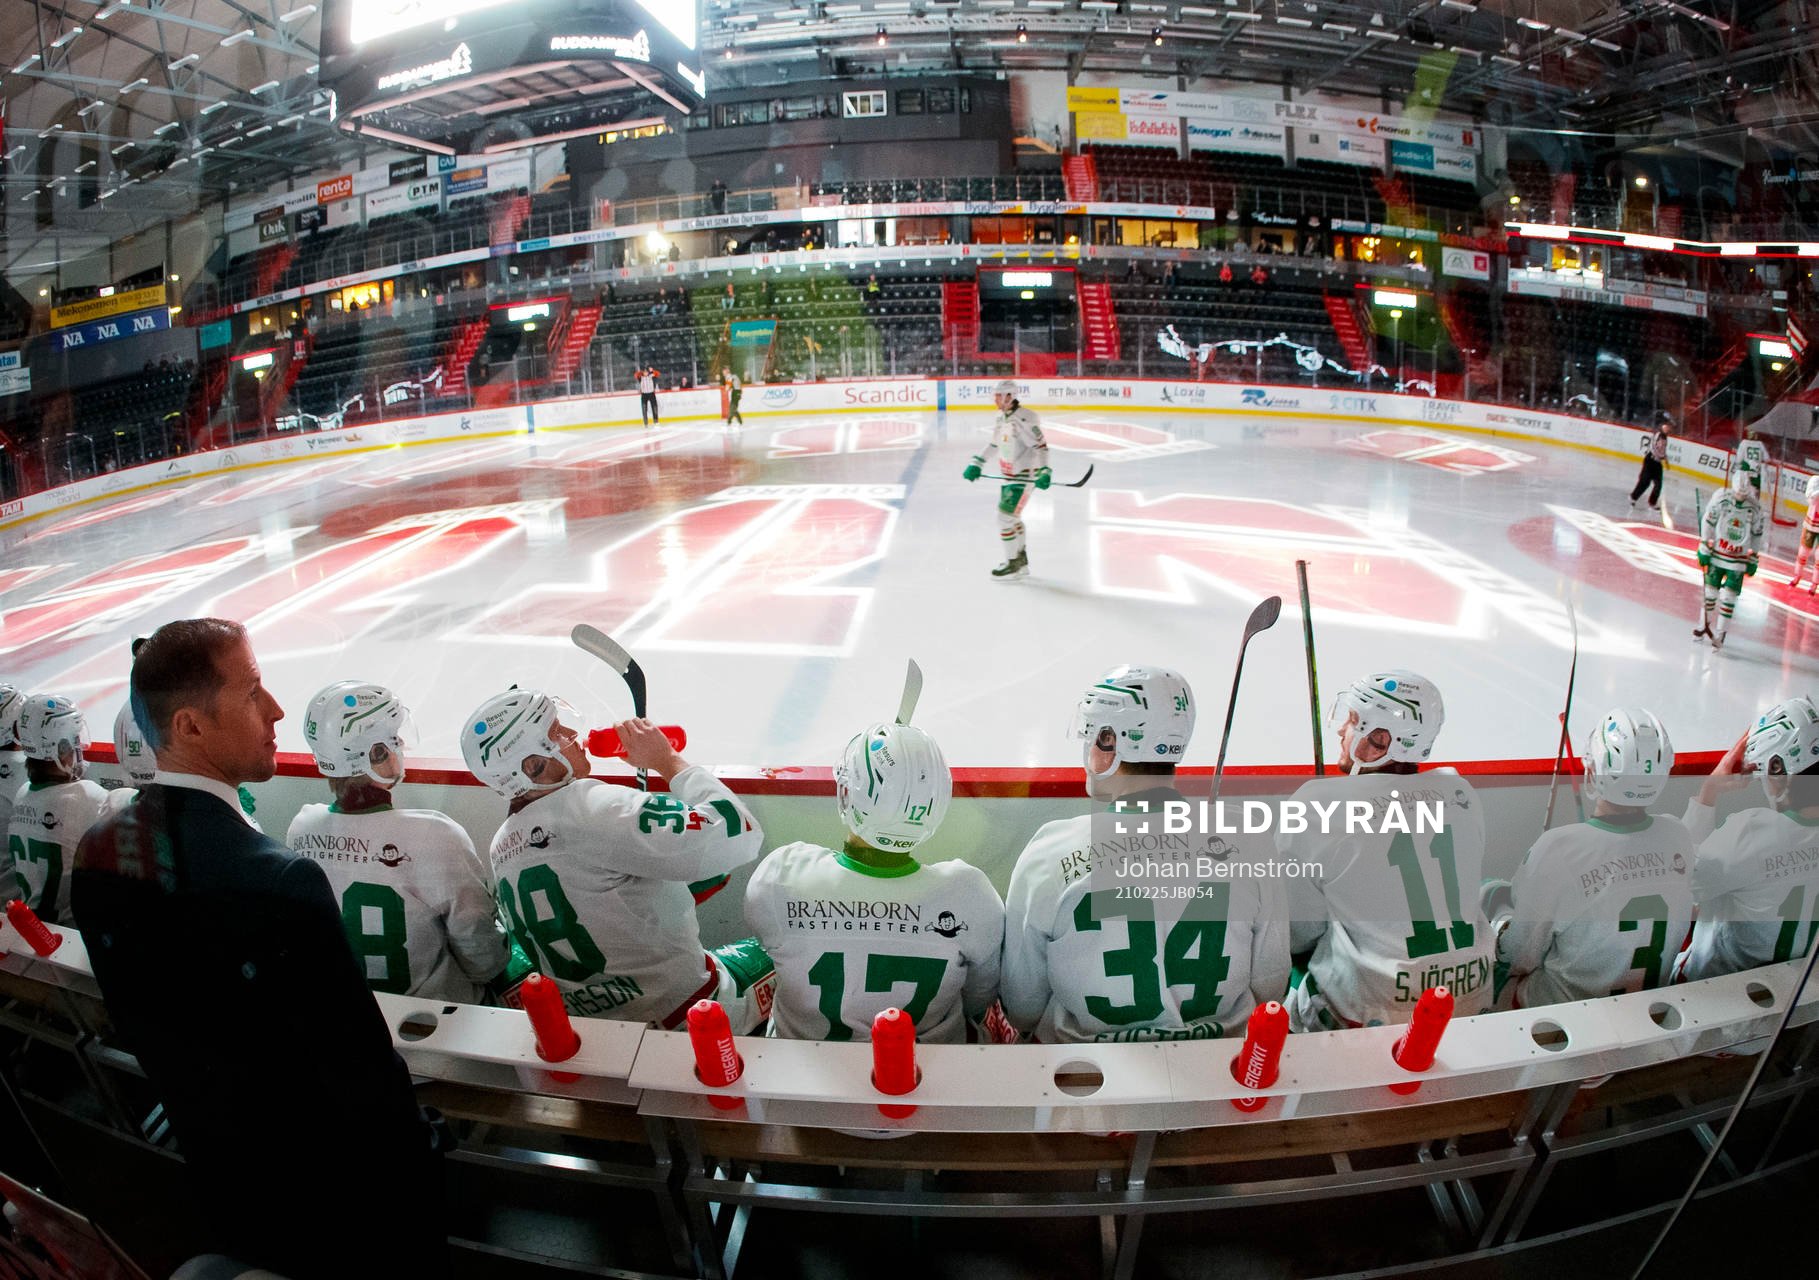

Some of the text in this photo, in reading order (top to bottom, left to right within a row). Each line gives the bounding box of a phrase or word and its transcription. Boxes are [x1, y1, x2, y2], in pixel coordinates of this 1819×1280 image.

[319, 179, 351, 198] renta
[412, 182, 439, 197] PTM
[57, 298, 118, 319] Mekonomen
[62, 315, 156, 348] NA NA NA
[844, 384, 928, 404] Scandic
[1174, 386, 1206, 398] Loxia
[1423, 400, 1463, 414] TRAVEL
[485, 708, 508, 724] Resurs
[488, 718, 504, 730] Bank
[128, 741, 141, 753] 90
[1644, 759, 1653, 774] 3
[908, 805, 927, 822] 17
[1060, 833, 1190, 875] BRÄNNBORN
[1581, 852, 1666, 890] BRÄNNBORN
[1387, 824, 1475, 959] 11
[1584, 867, 1667, 898] FASTIGHETER
[787, 900, 921, 923] BRÄNNBORN
[788, 920, 919, 935] FASTIGHETER
[1073, 881, 1231, 1026] 34
[1394, 955, 1490, 1003] SJÖGREN
[808, 951, 949, 1042] 17
[717, 1038, 739, 1083] ENERVIT
[1243, 1041, 1268, 1090] ENERVIT
